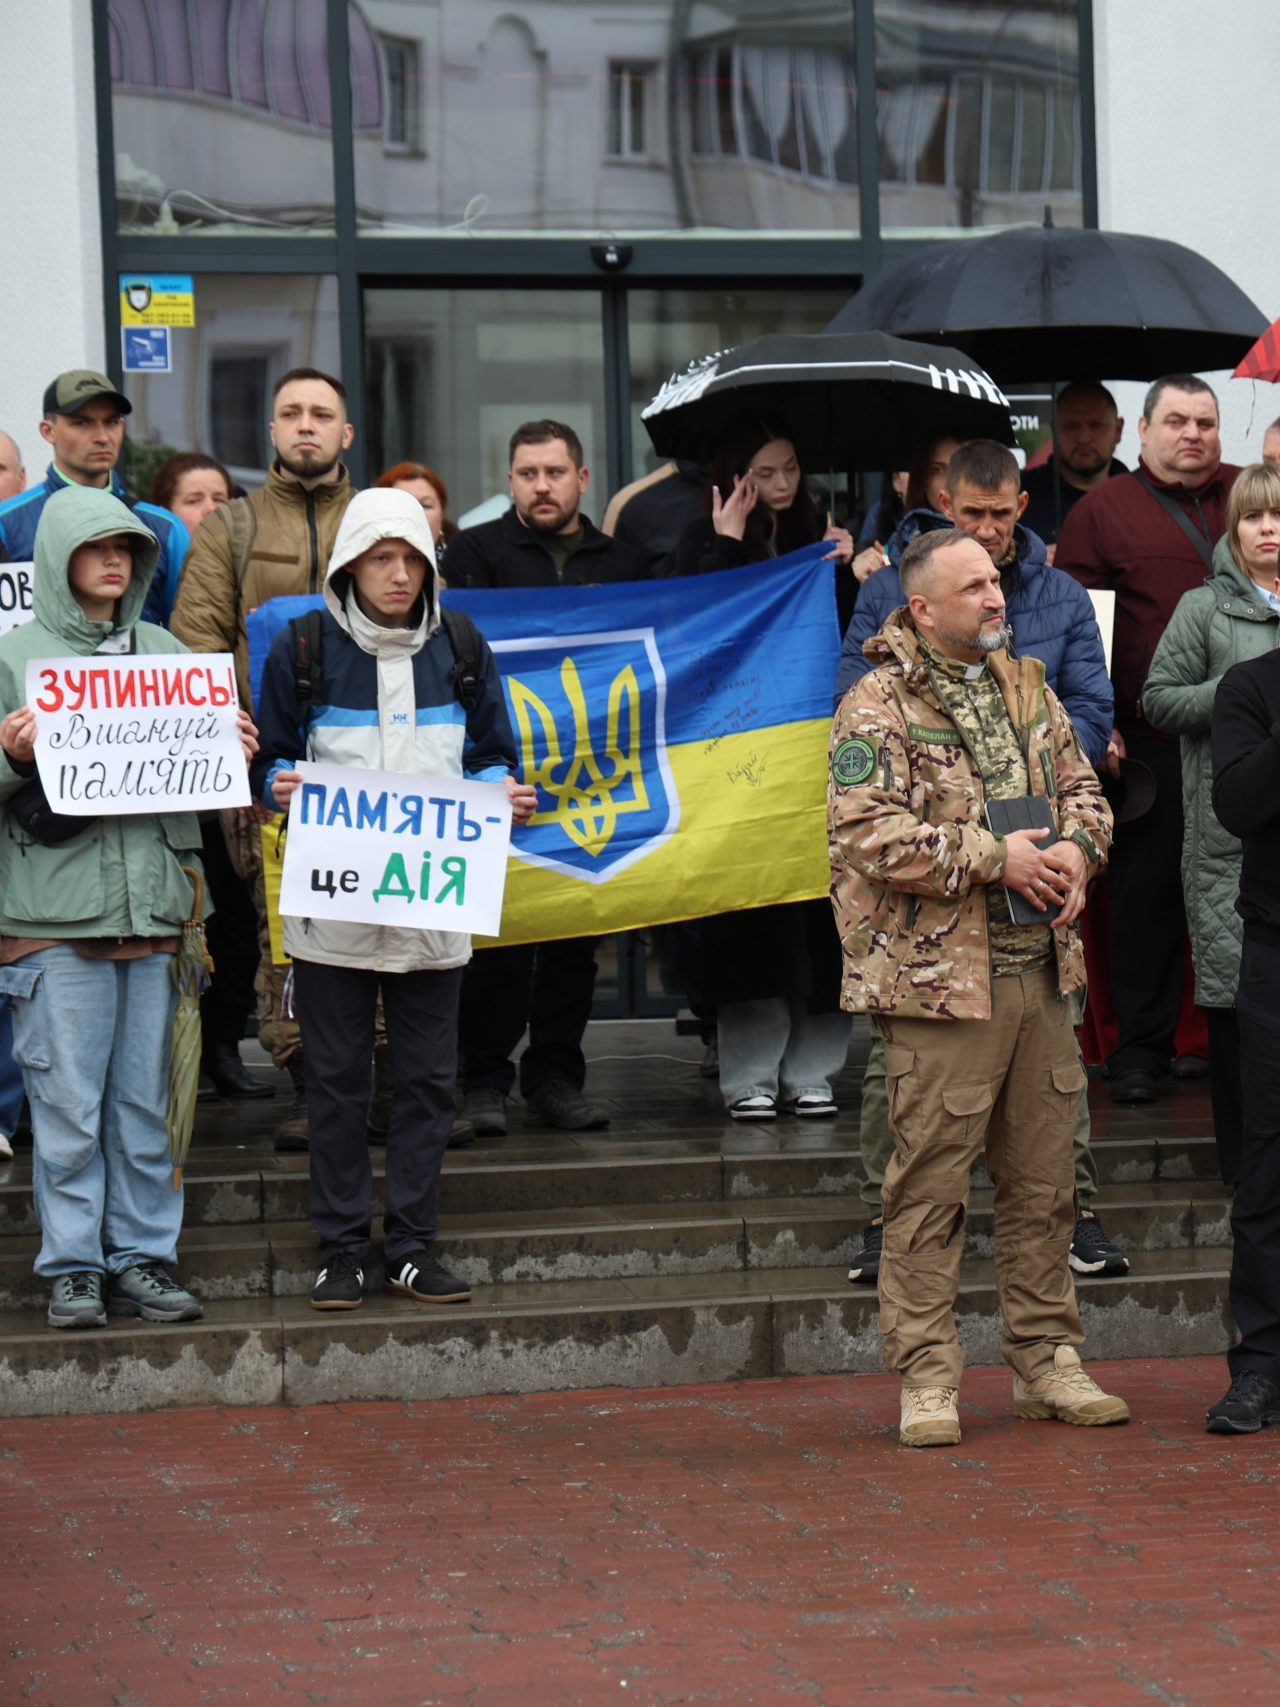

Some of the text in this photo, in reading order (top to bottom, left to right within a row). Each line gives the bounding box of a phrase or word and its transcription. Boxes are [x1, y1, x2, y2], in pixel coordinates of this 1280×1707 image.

[36, 667, 238, 713] ЗУПИНИСЬ!
[50, 712, 219, 756] Вшануй
[918, 729, 951, 740] КАПЕЛАН
[59, 750, 232, 800] пам'ять
[311, 868, 359, 899] це
